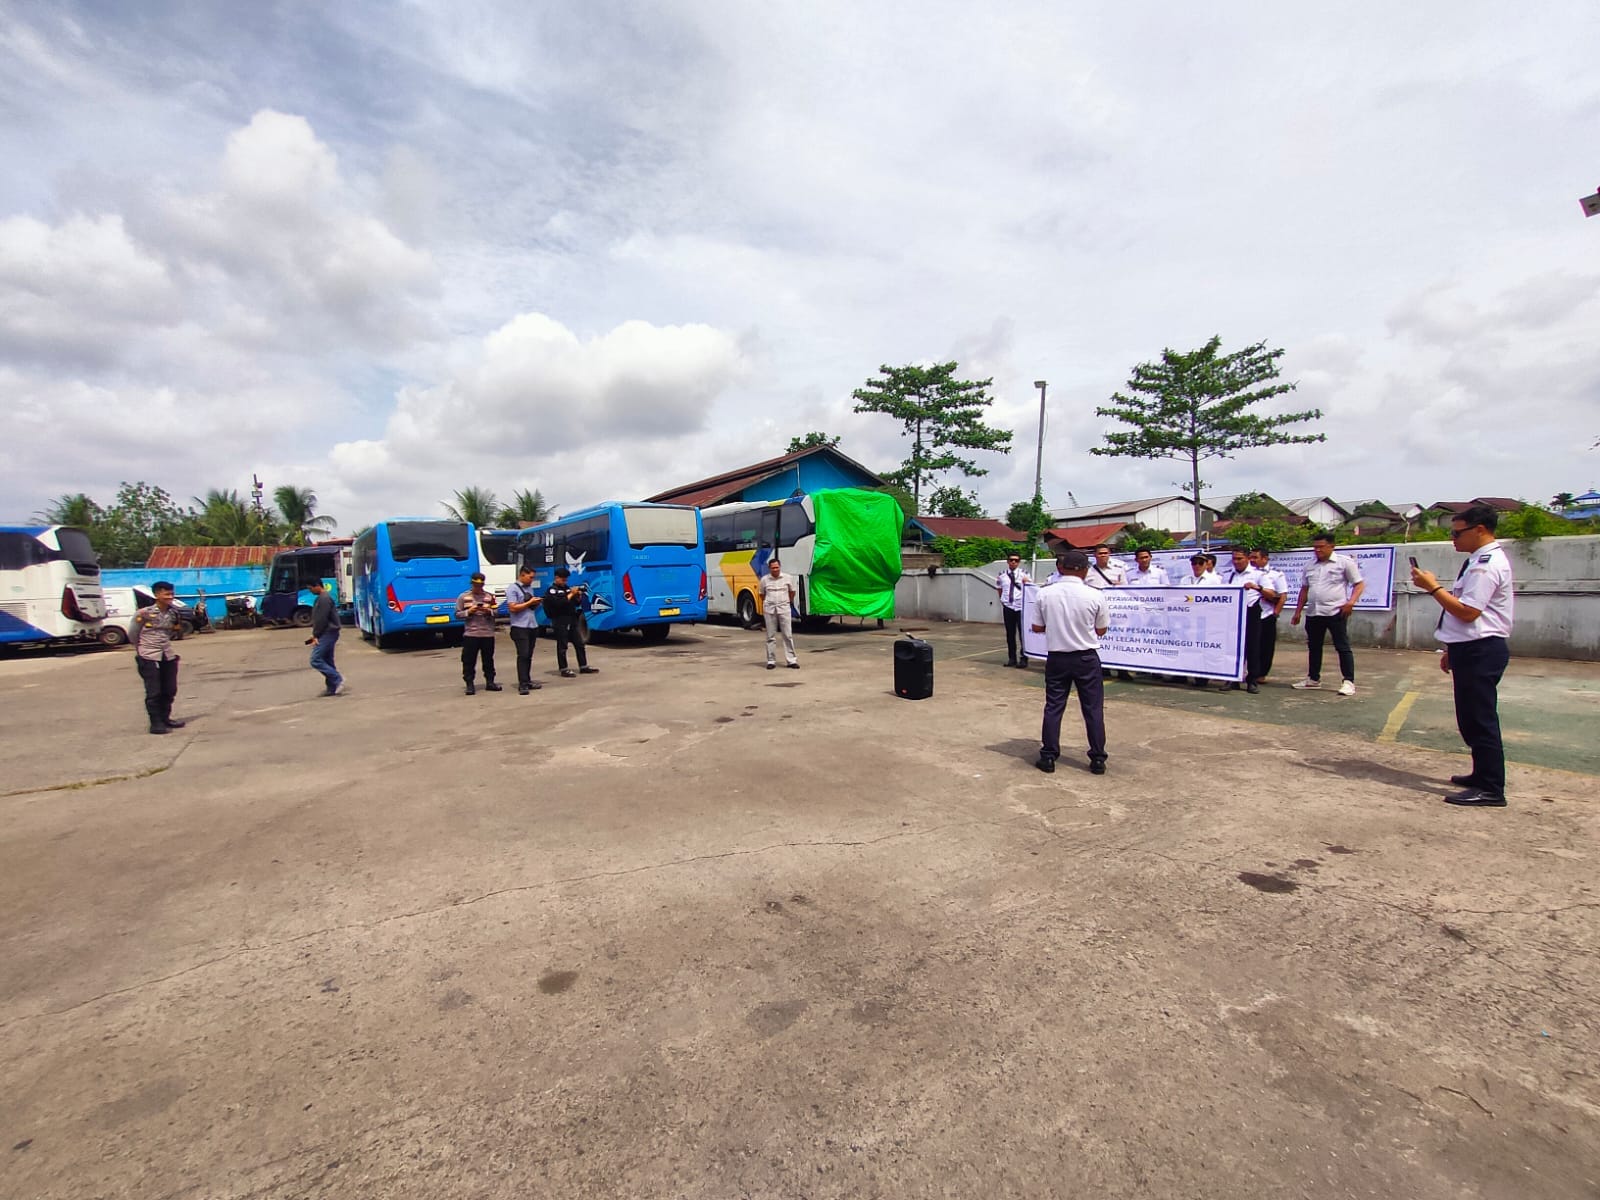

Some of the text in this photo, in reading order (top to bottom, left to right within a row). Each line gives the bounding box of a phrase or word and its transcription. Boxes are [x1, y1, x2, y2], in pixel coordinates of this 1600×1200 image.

[1194, 595, 1233, 604] DAMRI
[1126, 627, 1171, 636] PESANGON
[1116, 636, 1141, 644] LELAH
[1143, 638, 1193, 647] MENUNGGU
[1196, 641, 1222, 649] TIDAK
[1113, 645, 1153, 654] HILALNYA
